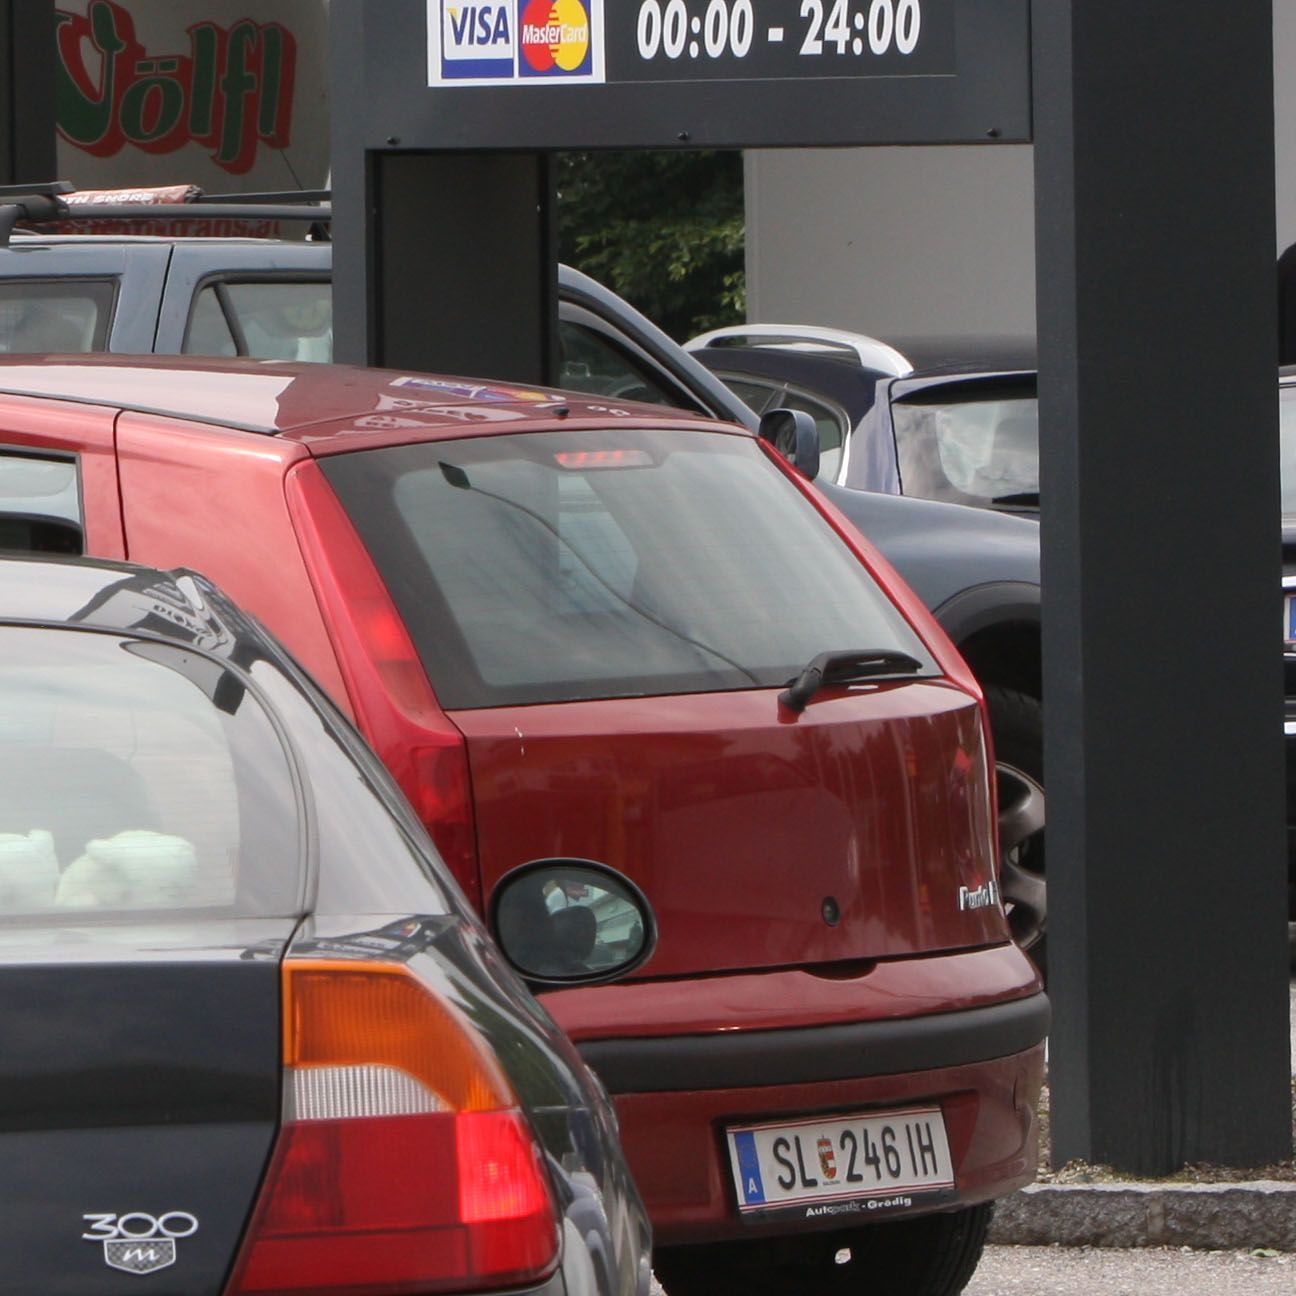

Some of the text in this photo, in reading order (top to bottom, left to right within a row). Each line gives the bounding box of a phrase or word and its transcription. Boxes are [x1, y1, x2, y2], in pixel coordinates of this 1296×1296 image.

[446, 5, 510, 46] VISA
[522, 22, 589, 46] MasterCard
[773, 1134, 818, 1191] SL
[82, 1211, 199, 1239] 300
